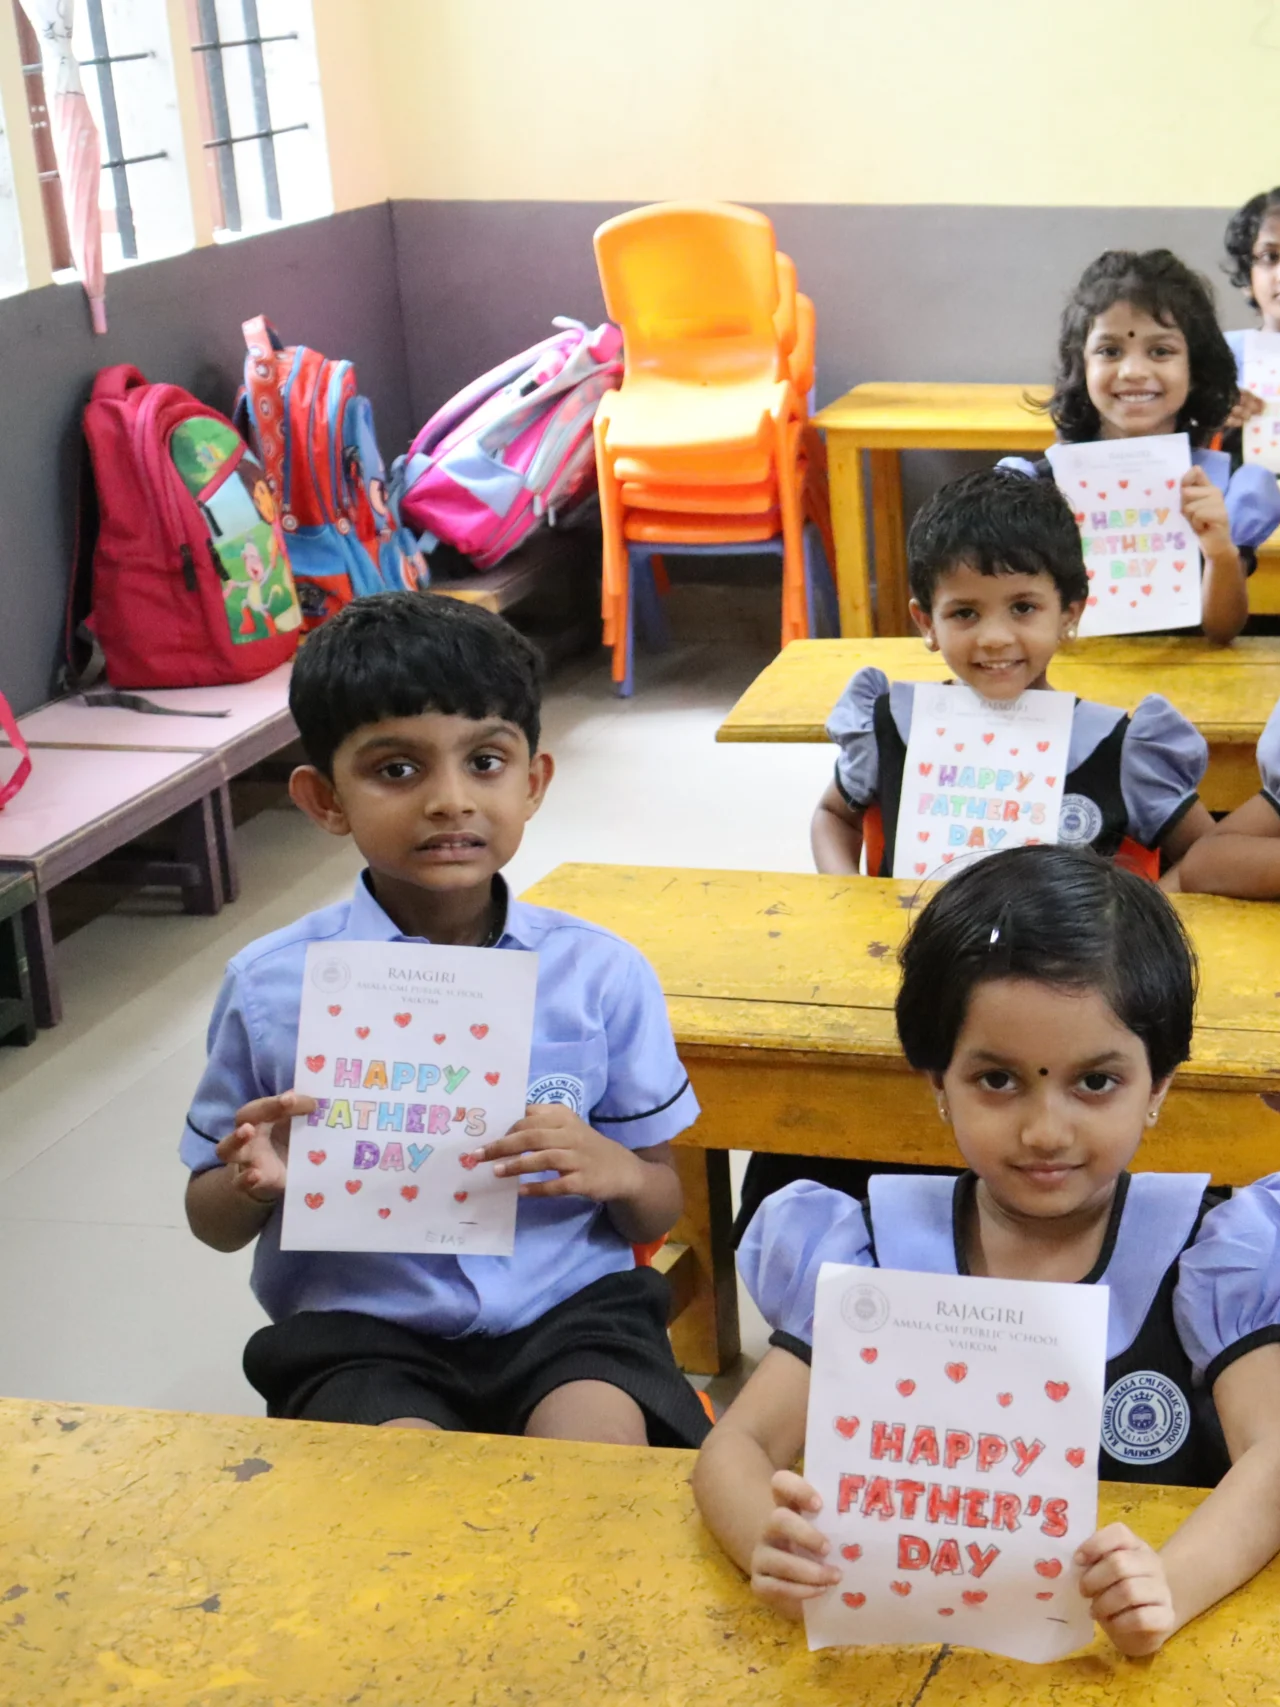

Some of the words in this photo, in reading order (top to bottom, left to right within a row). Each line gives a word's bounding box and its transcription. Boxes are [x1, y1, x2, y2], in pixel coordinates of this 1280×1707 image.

[1091, 507, 1170, 530] HAPPY
[1110, 558, 1158, 579] DAY
[938, 764, 1035, 792] HAPPY
[917, 792, 1046, 825] FATHER'S
[948, 823, 1007, 848] DAY
[388, 967, 456, 983] RAJAGIRI
[333, 1057, 470, 1094] HAPPY
[307, 1097, 487, 1137] FATHER'S
[352, 1140, 435, 1173] DAY
[936, 1300, 1024, 1325] RAJAGIRI
[893, 1318, 932, 1332] AMALA
[935, 1323, 959, 1335] CMI
[962, 1326, 1003, 1341] PUBLIC
[1009, 1332, 1058, 1347] SCHOOL
[948, 1339, 997, 1353] VAIKOM
[1110, 1379, 1137, 1404] AMALA
[1138, 1377, 1156, 1387] CMI
[1156, 1380, 1180, 1408] PUBLIC
[1164, 1410, 1183, 1446] SCHOOL
[869, 1420, 1046, 1477] HAPPY
[1123, 1446, 1161, 1457] VAIKOM
[836, 1472, 1069, 1538] FATHER'S
[896, 1533, 1001, 1578] DAY
